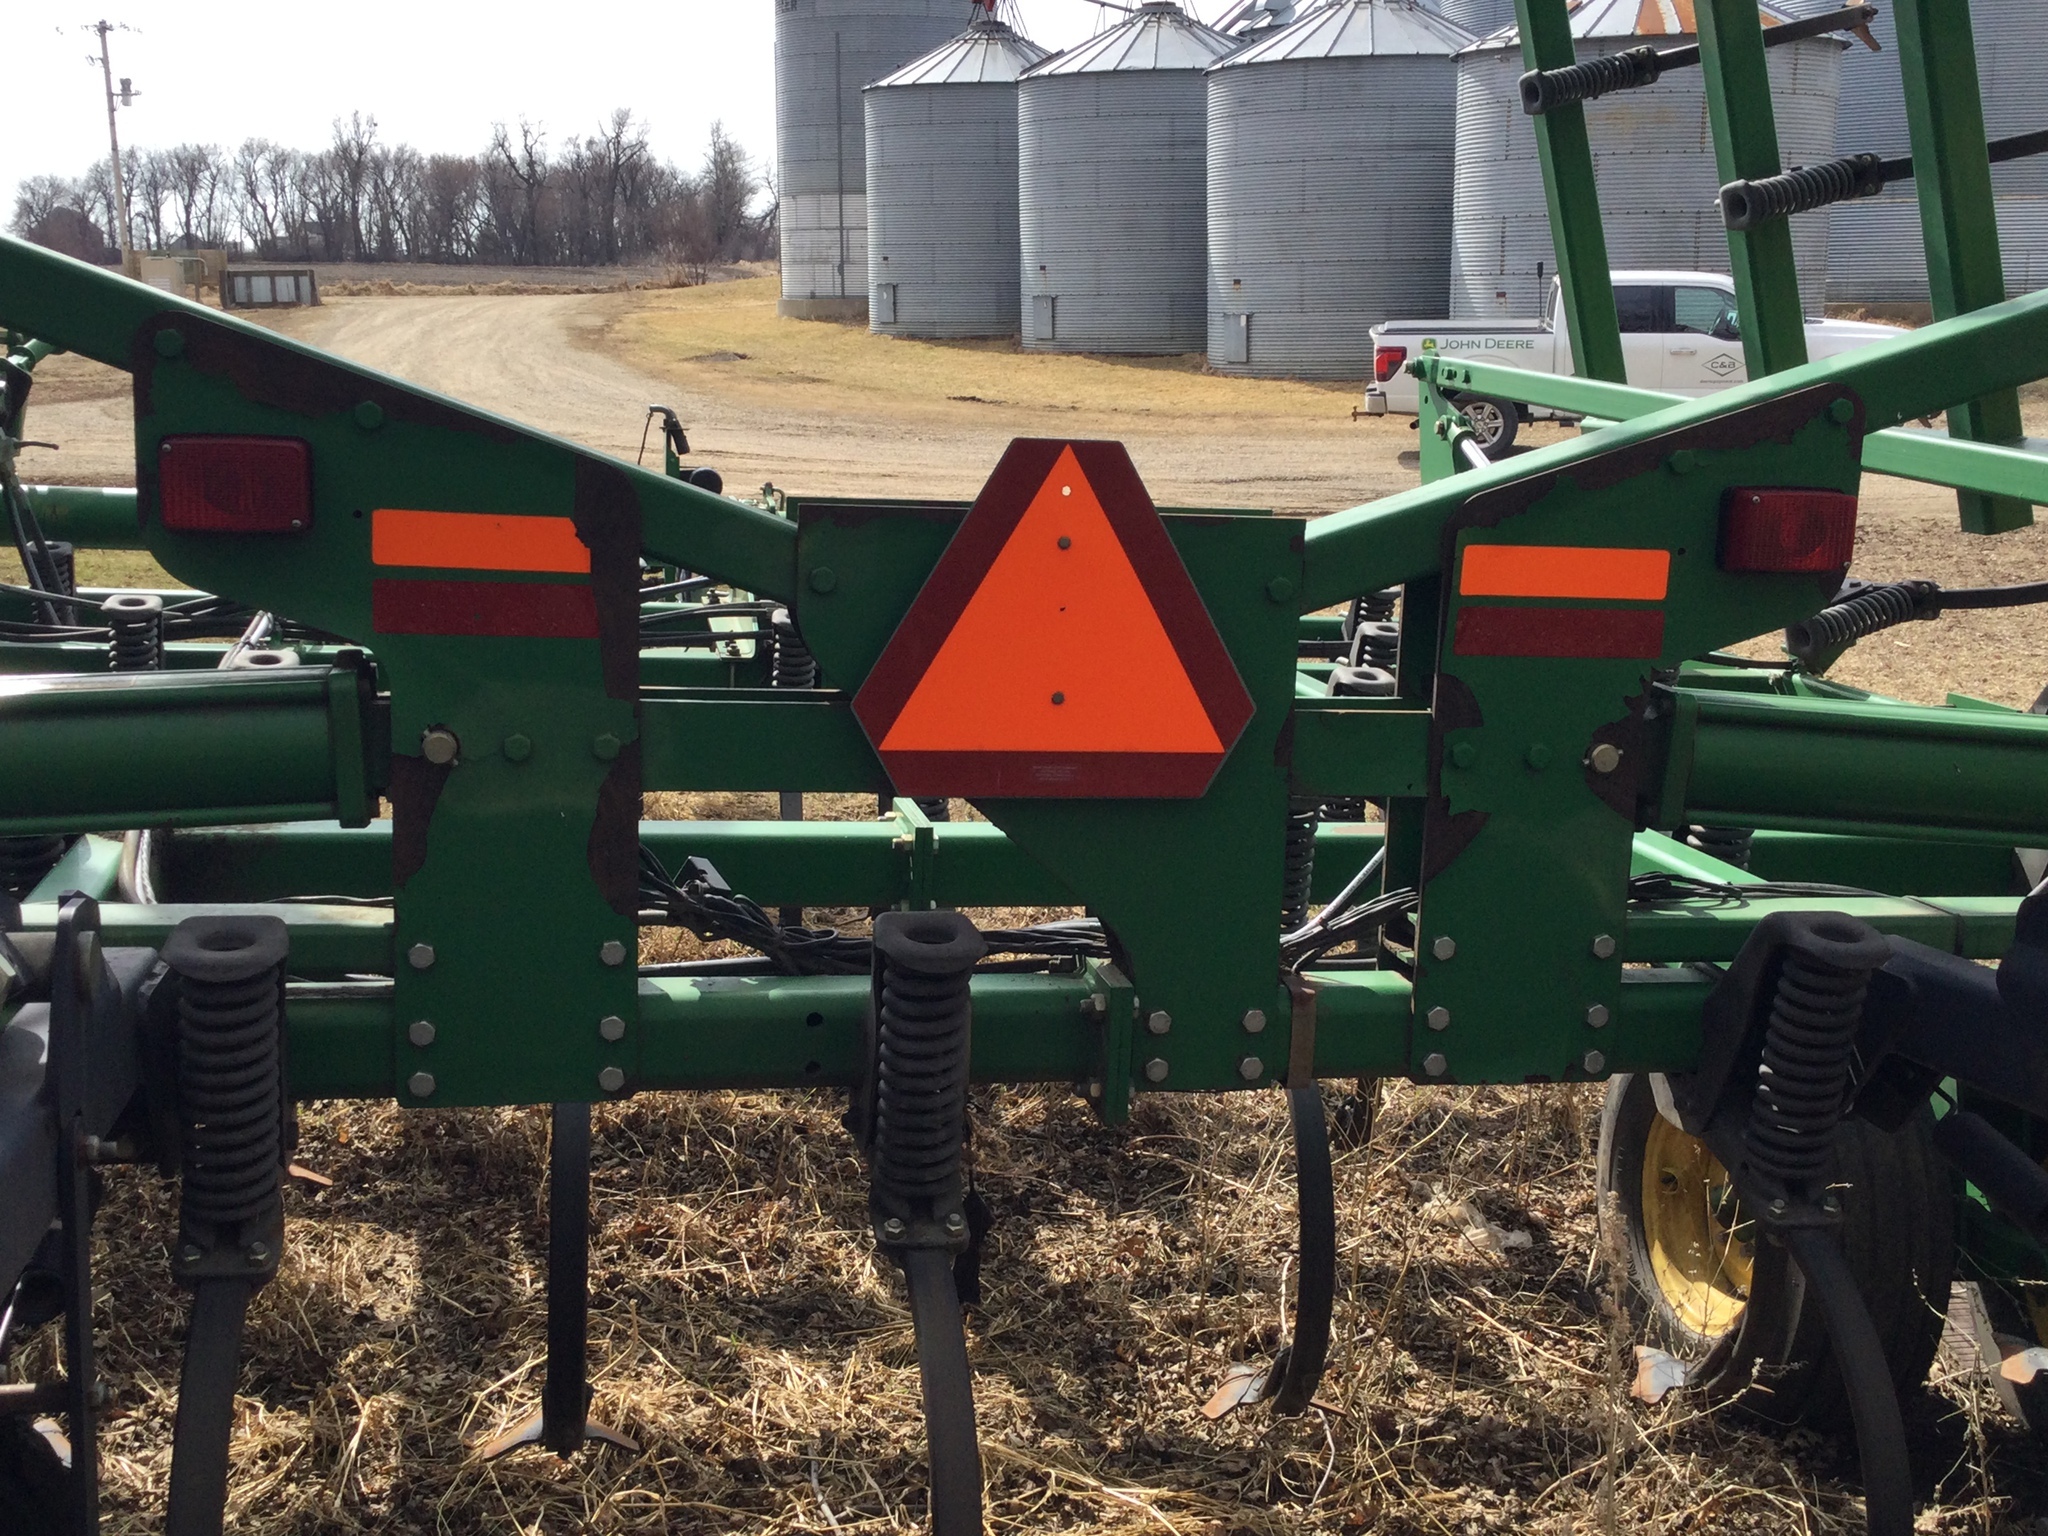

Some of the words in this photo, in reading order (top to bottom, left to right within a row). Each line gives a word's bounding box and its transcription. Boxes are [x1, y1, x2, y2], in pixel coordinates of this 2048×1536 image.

[1440, 338, 1480, 350] JOHN
[1485, 338, 1534, 349] DEERE
[1710, 361, 1736, 369] C&B
